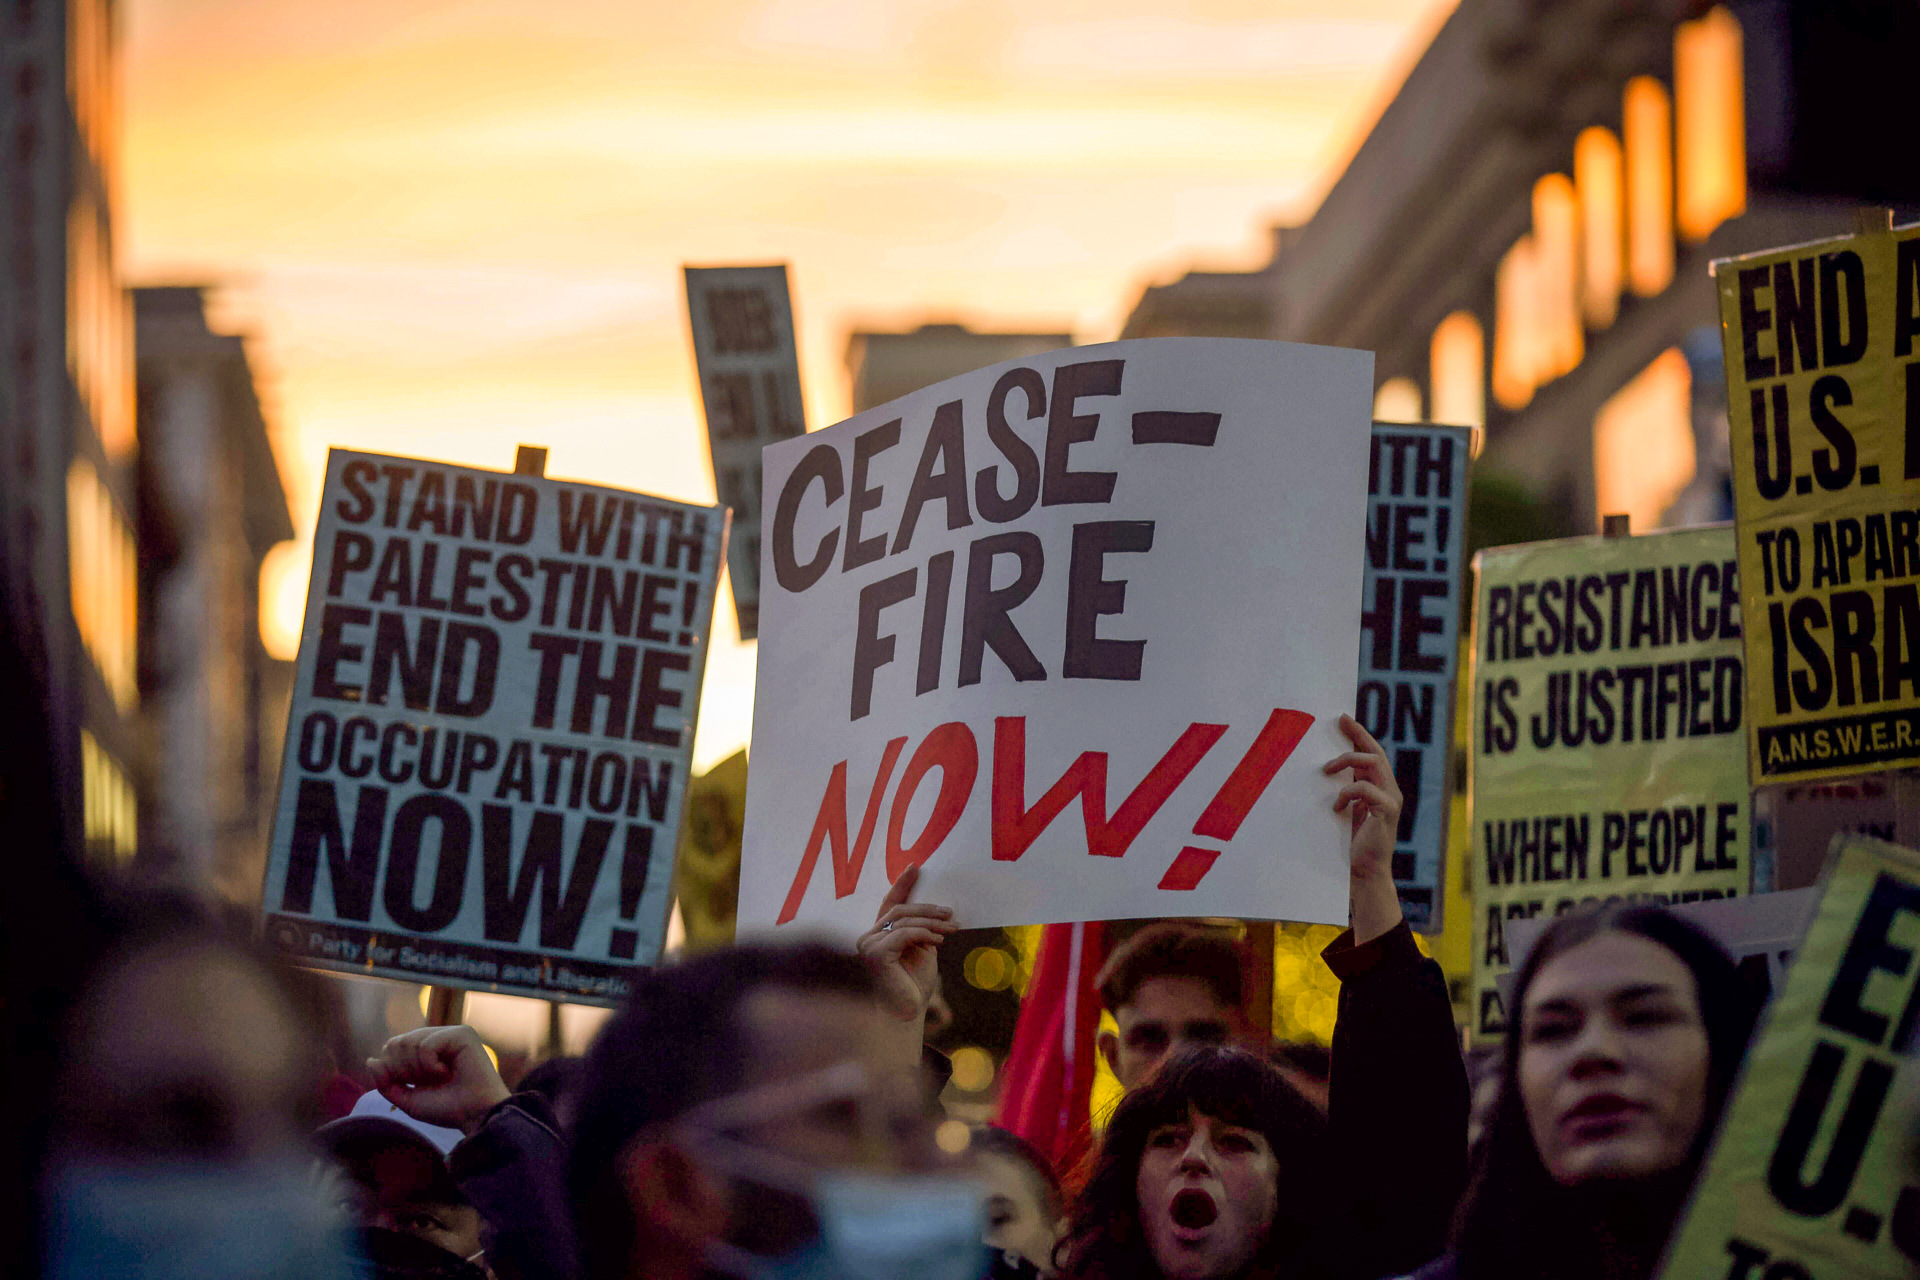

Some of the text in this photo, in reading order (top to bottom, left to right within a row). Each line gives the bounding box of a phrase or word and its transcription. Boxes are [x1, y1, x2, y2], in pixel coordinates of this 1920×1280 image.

[1739, 250, 1868, 382] END
[772, 359, 1222, 593] CEASE-
[1750, 375, 1880, 501] U.S.
[335, 460, 538, 545] STAND
[558, 488, 711, 573] WITH
[1756, 509, 1920, 597] TO APAR
[327, 530, 699, 647] PALESTINE!
[850, 520, 1155, 722] FIRE
[1487, 560, 1742, 662] RESISTANCE
[312, 604, 692, 748] END THE
[1483, 655, 1743, 755] IS JUSTIFIED
[1767, 584, 1920, 716] ISRA
[297, 710, 673, 824] OCCUPATION
[776, 708, 1315, 926] NOW!
[281, 777, 655, 961] NOW!
[1484, 803, 1739, 887] WHEN PEOPLE
[309, 931, 361, 961] Party
[399, 946, 498, 981] Socialism
[502, 964, 543, 985] and
